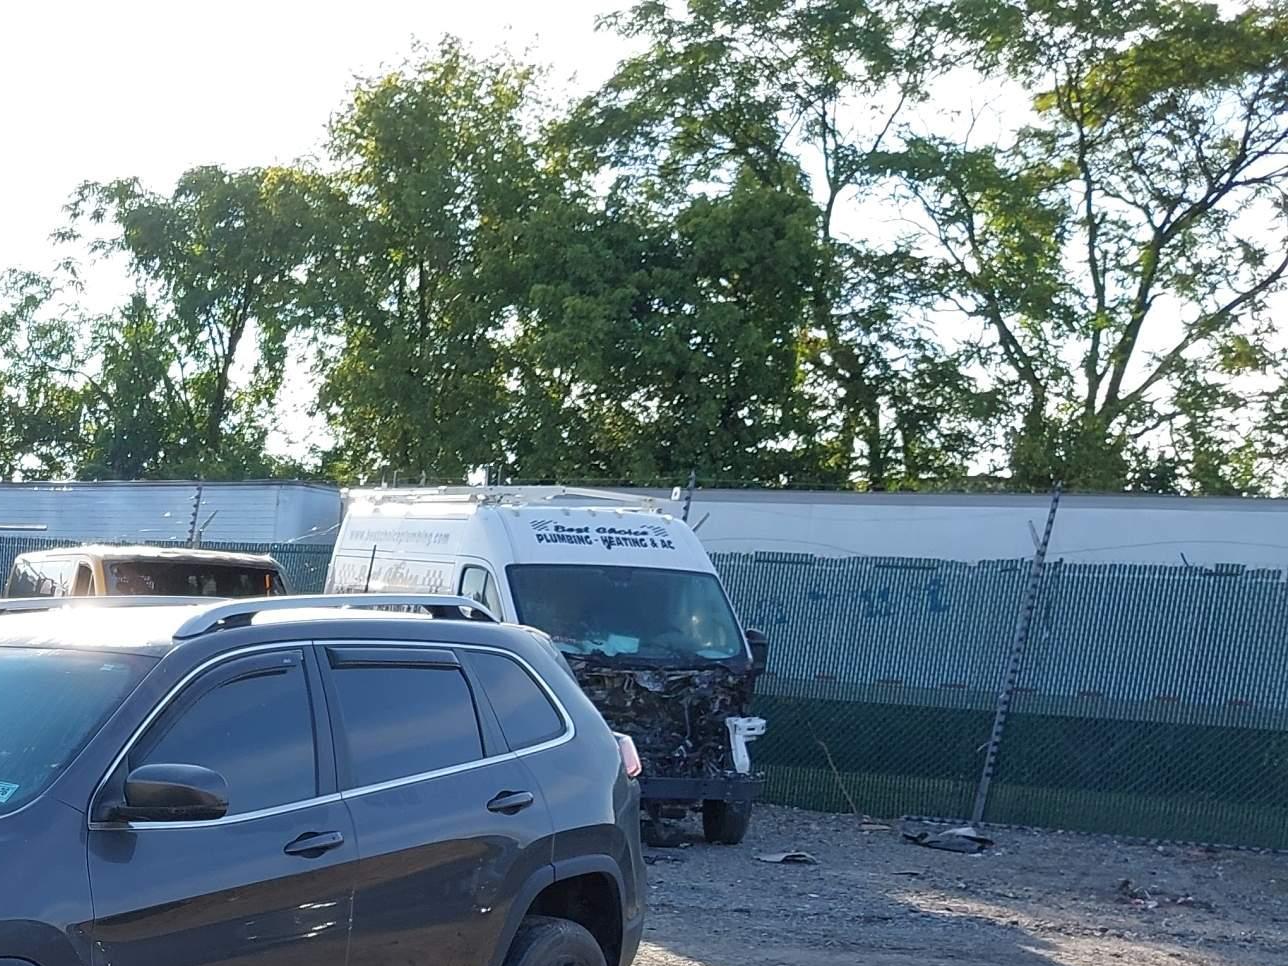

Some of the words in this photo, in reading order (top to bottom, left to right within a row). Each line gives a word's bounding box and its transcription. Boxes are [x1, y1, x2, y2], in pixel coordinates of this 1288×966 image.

[554, 525, 590, 534] Best
[595, 526, 649, 536] Choice
[536, 533, 593, 545] PLUMBING
[600, 536, 648, 549] HEATING
[660, 540, 675, 550] AC
